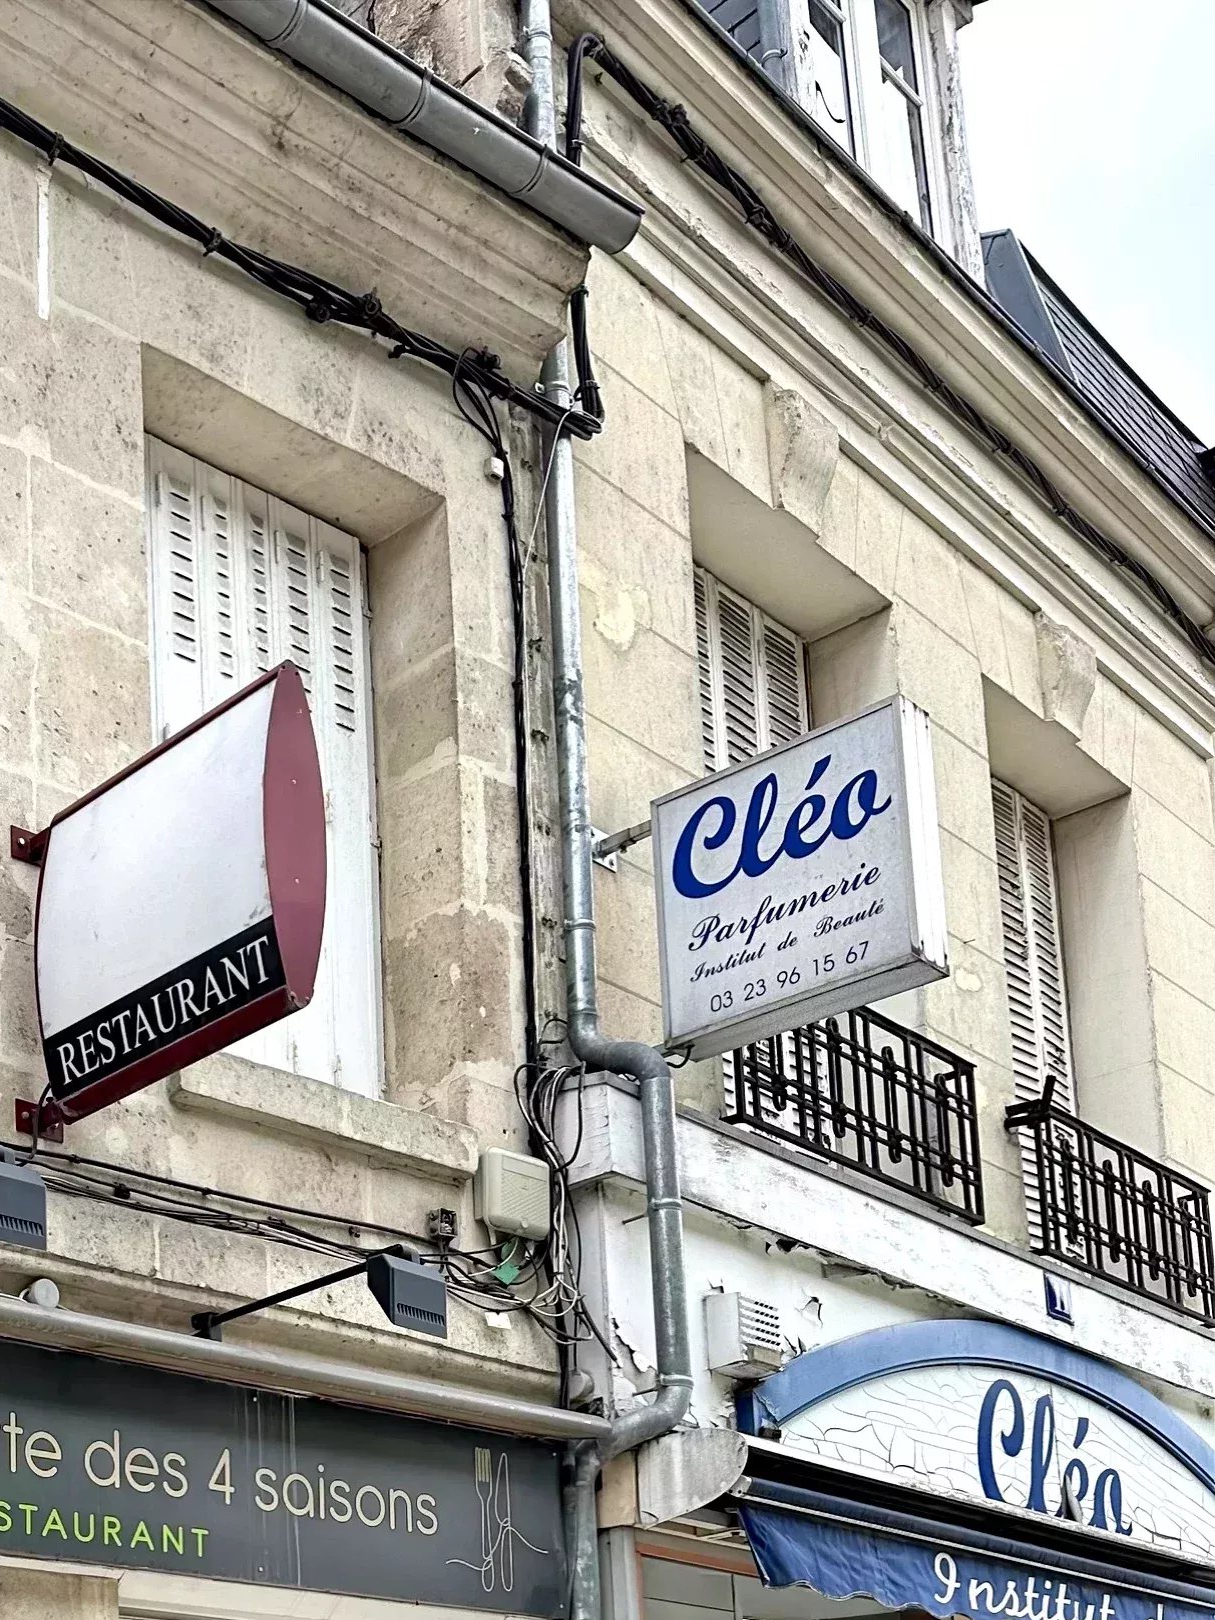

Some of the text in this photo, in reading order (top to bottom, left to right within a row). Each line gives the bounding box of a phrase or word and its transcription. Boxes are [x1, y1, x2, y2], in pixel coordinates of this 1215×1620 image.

[671, 753, 893, 899] Cléo
[687, 862, 882, 952] Parfumerie
[689, 897, 886, 984] Institut de Beauté
[56, 935, 271, 1086] RESTAURANT
[709, 940, 871, 1014] 03 23 96 15 67
[83, 1429, 188, 1499] des
[207, 1447, 236, 1506] 4
[254, 1463, 439, 1537] saisons
[976, 1377, 1133, 1537] Cléo
